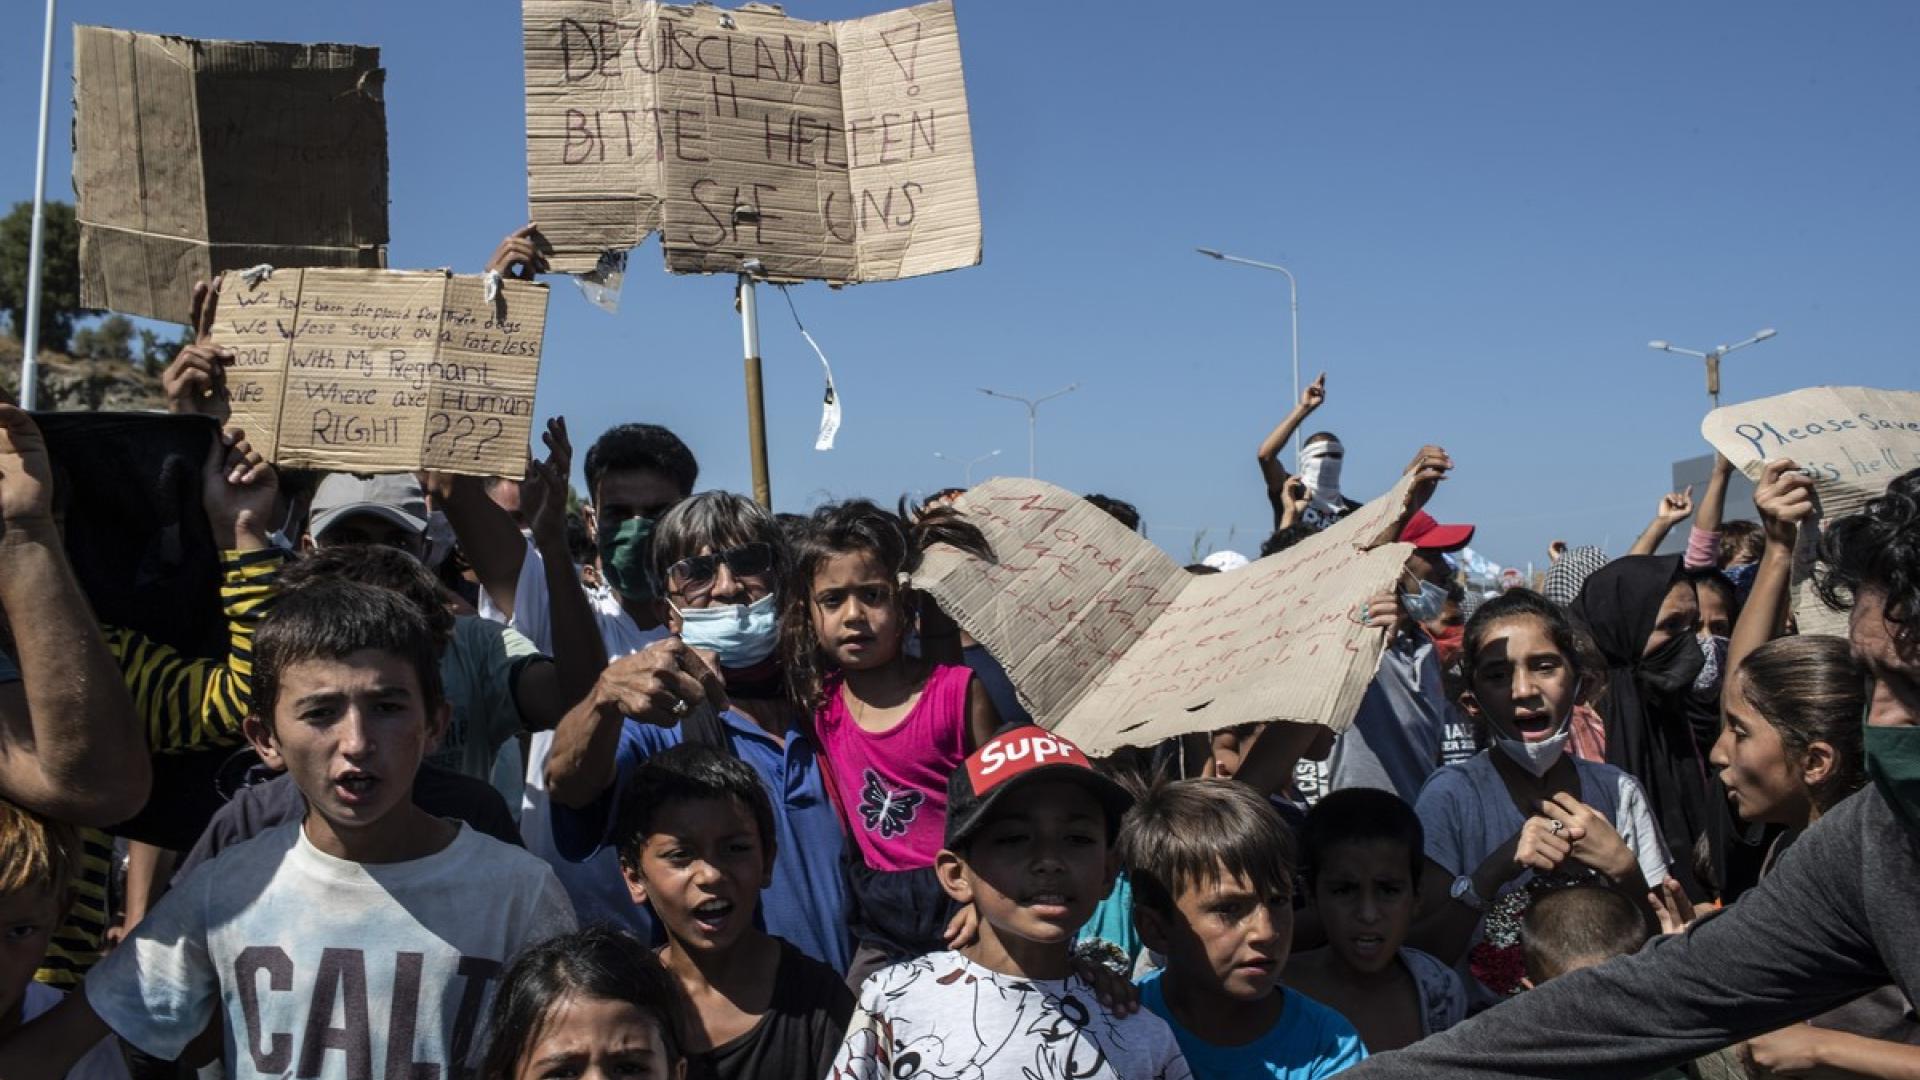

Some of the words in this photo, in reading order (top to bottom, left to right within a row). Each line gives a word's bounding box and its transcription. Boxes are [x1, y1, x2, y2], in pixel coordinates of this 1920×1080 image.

[562, 109, 709, 165] BITTE
[825, 182, 923, 243] UNS
[236, 291, 269, 306] We
[232, 319, 268, 335] We
[346, 350, 374, 377] My
[305, 381, 377, 405] Where
[393, 391, 428, 408] are
[441, 389, 531, 416] Human
[311, 407, 410, 445] RIGHT
[425, 412, 503, 461] ???
[1736, 419, 1857, 459] Please
[1840, 446, 1902, 477] hell
